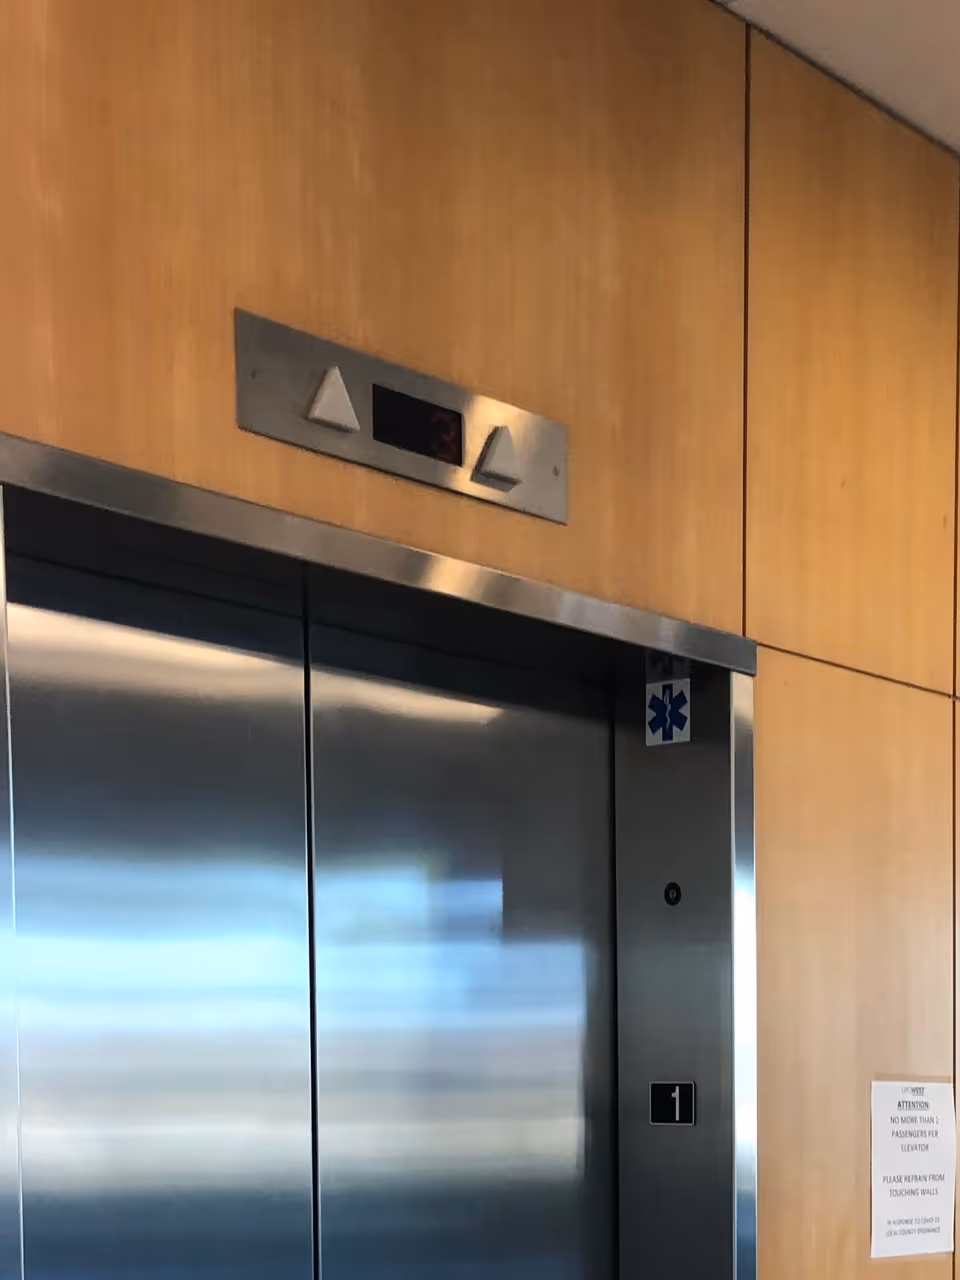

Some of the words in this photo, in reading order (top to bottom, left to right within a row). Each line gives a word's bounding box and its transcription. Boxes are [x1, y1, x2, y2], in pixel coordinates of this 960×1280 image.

[671, 1086, 680, 1121] 1
[890, 1116, 899, 1125] NO
[901, 1116, 917, 1125] MORE
[919, 1116, 934, 1125] THAN
[892, 1129, 927, 1139] PASSENGERS
[928, 1130, 939, 1139] PER
[901, 1143, 929, 1152] ELEVATOR
[882, 1174, 903, 1184] PLEASE
[904, 1174, 928, 1184] REFRAIN
[928, 1173, 945, 1182] FROM
[889, 1188, 919, 1198] TOUCHING
[920, 1187, 938, 1196] WALLS
[899, 1228, 916, 1236] COUNTY
